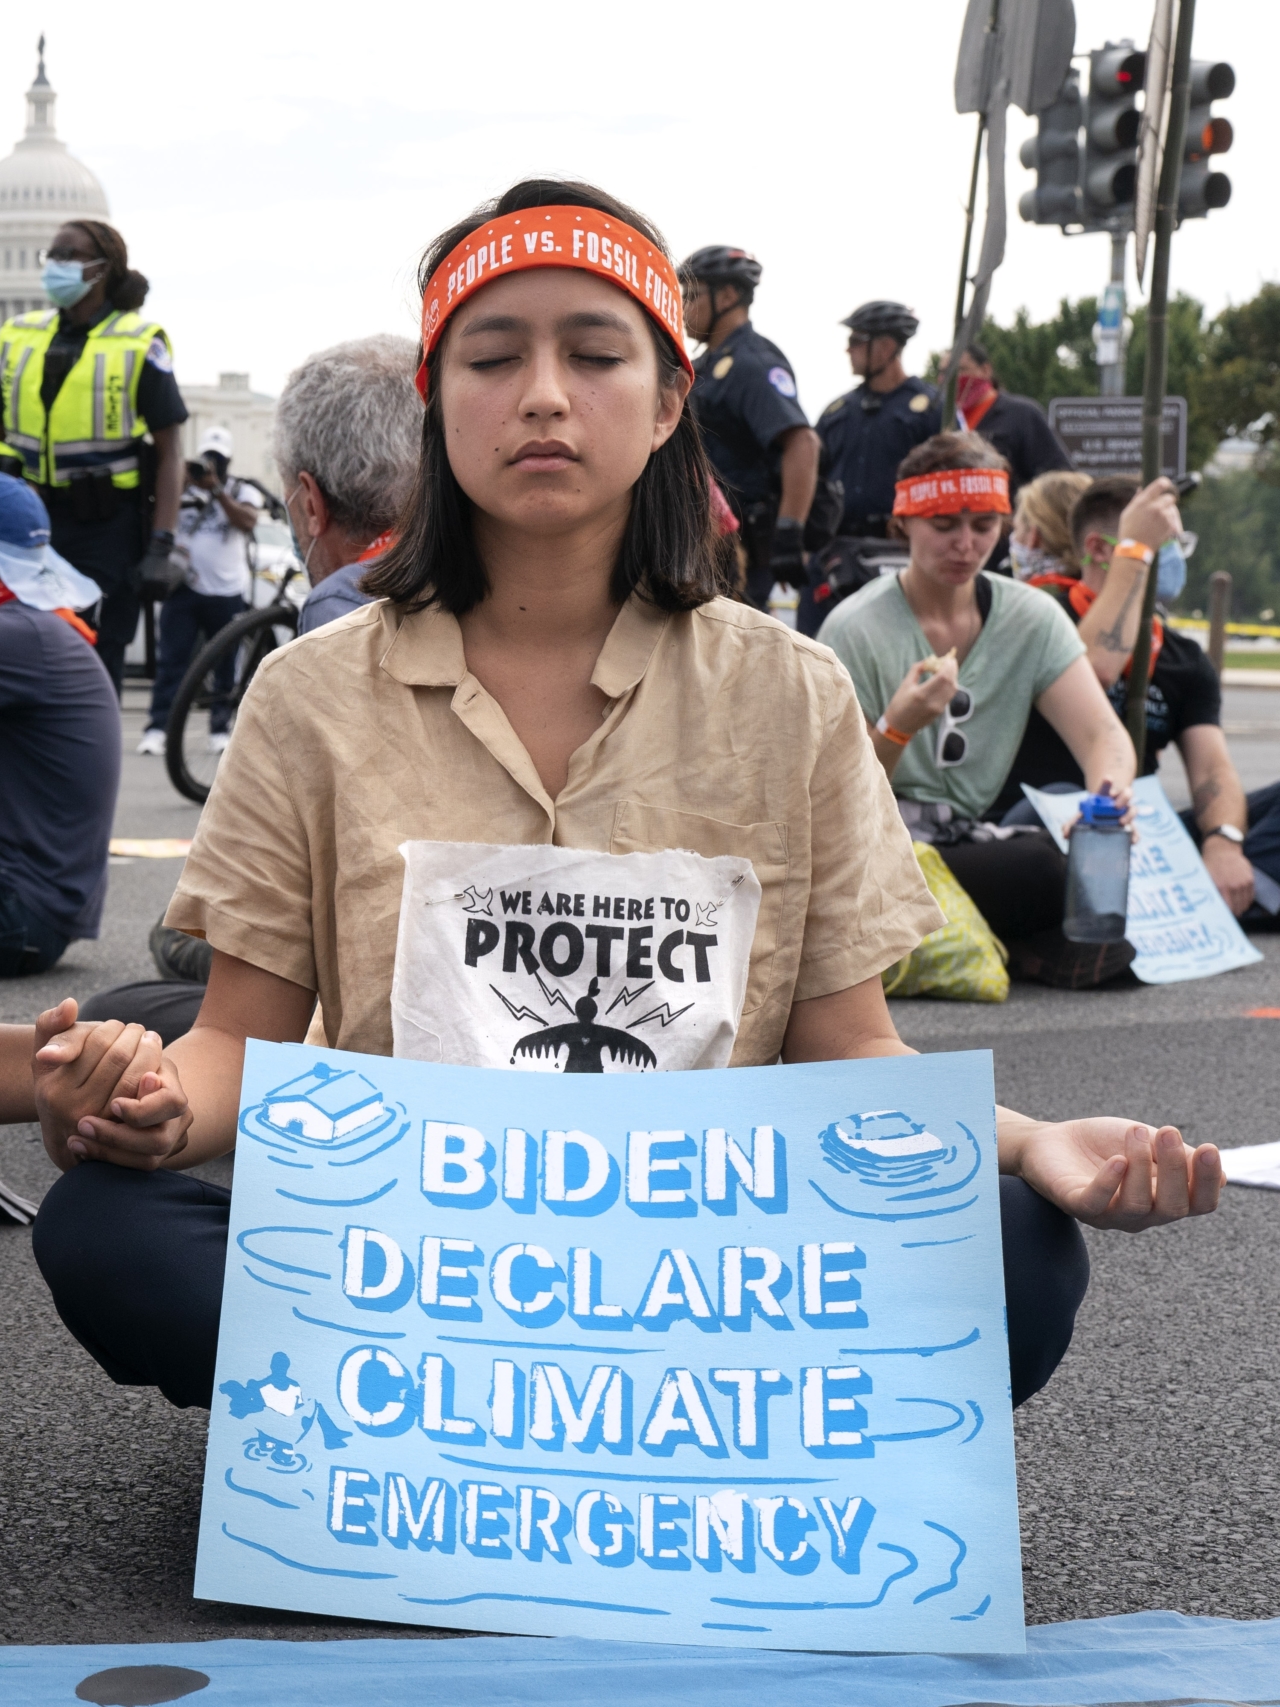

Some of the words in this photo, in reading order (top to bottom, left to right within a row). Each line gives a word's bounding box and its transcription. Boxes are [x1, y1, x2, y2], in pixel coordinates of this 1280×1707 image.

[447, 235, 513, 304] PEOPLE
[573, 229, 639, 290] FOSSIL
[644, 266, 679, 334] FUELS
[465, 918, 718, 983] PROTECT
[500, 890, 532, 915] WE
[537, 891, 585, 916] ARE
[593, 896, 655, 921] HERE
[660, 897, 690, 923] TO
[421, 1120, 788, 1217] BIDEN
[339, 1225, 869, 1332] DECLARE
[336, 1345, 876, 1458] CLIMATE
[325, 1466, 878, 1575] EMERGENCY
